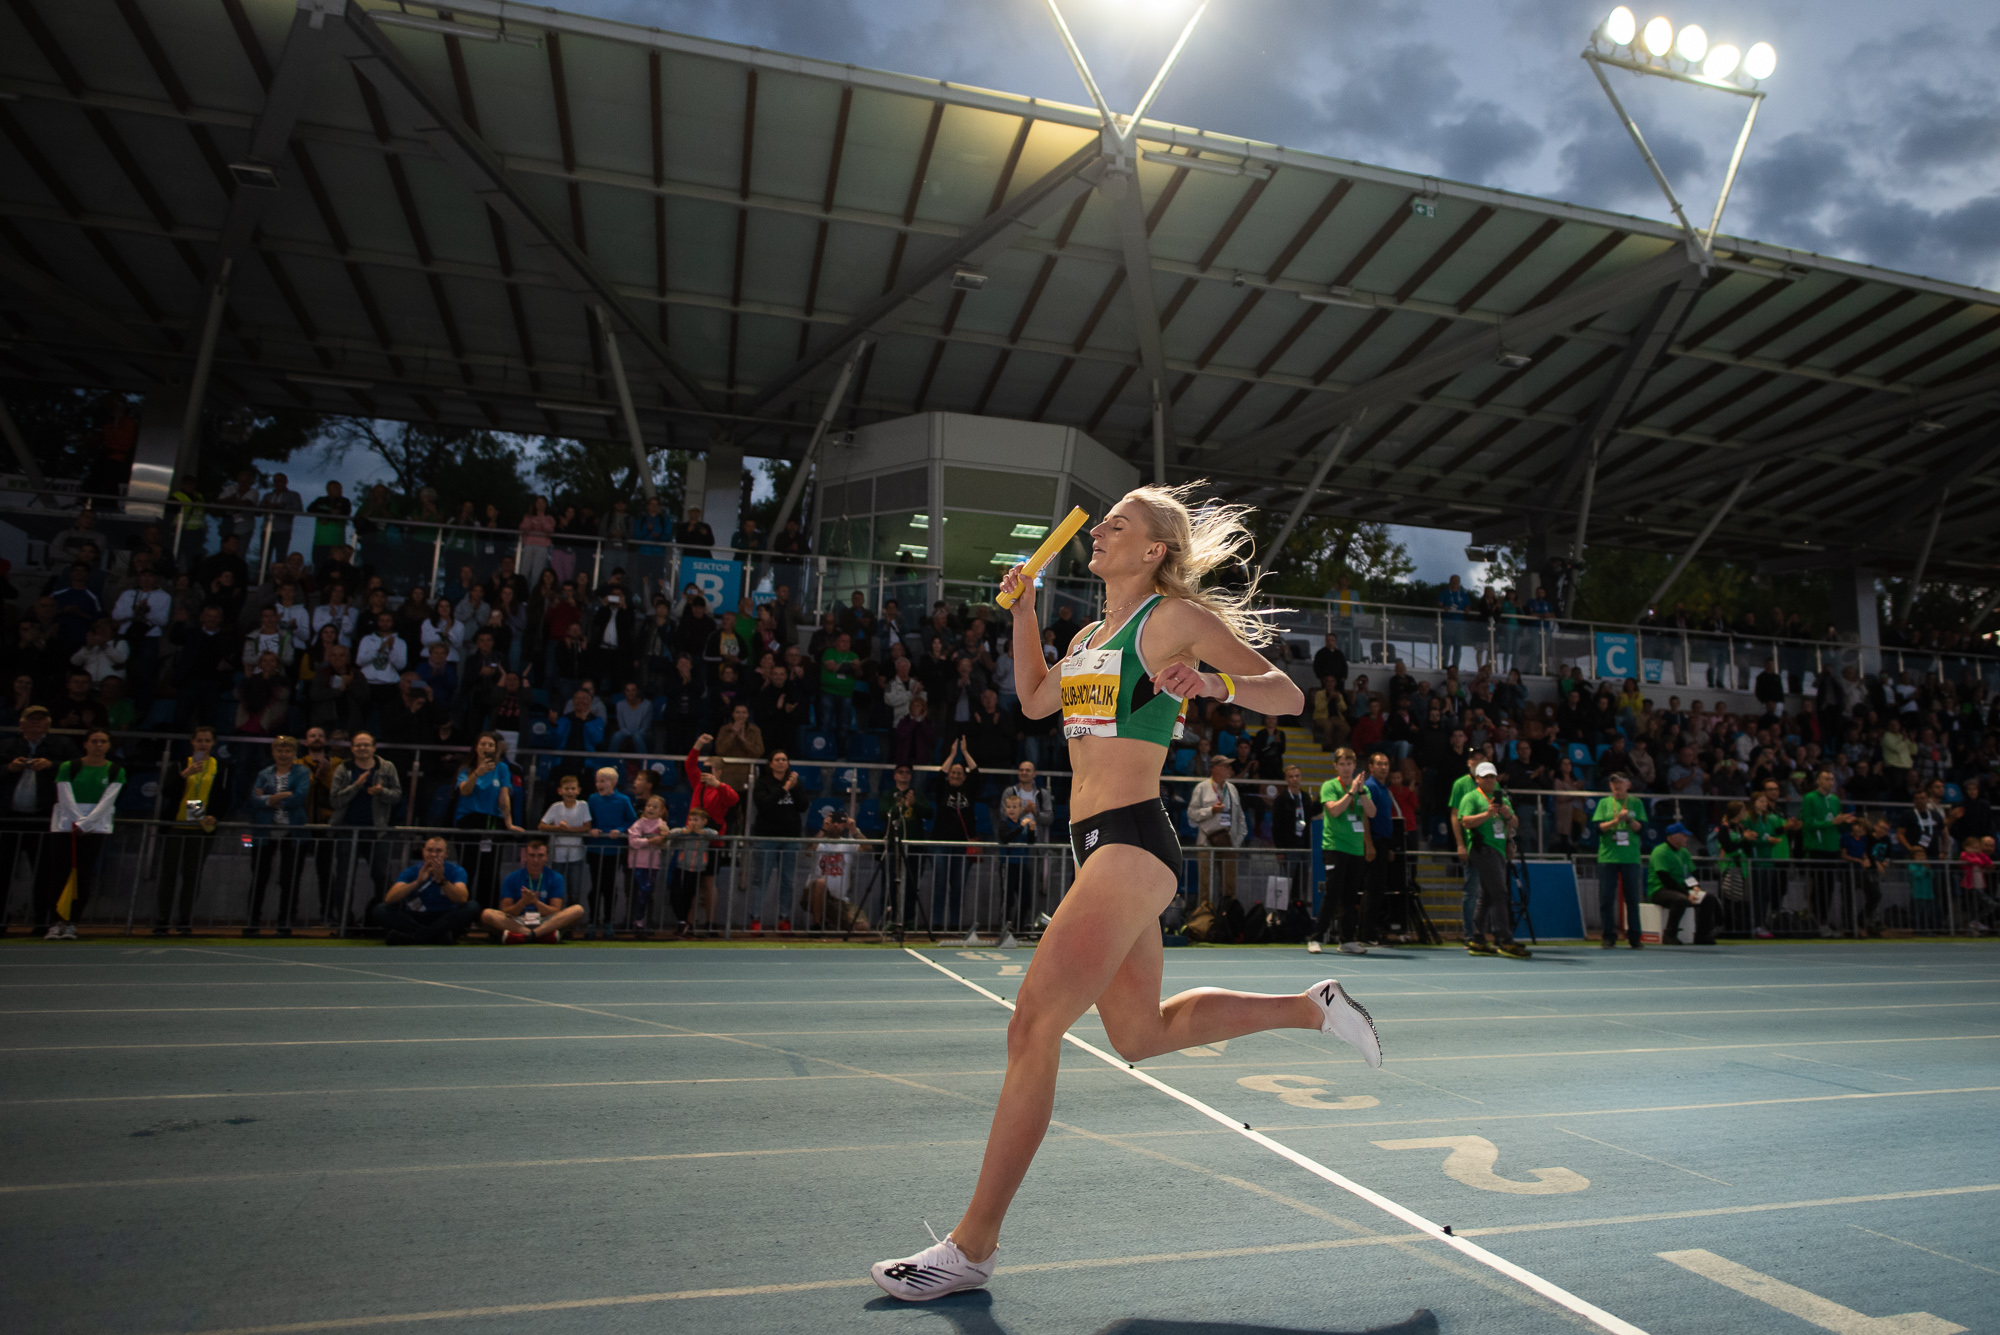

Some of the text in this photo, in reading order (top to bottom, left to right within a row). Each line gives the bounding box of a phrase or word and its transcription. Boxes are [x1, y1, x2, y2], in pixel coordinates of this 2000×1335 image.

[692, 561, 730, 573] SEKTOR
[694, 573, 724, 616] B
[1093, 653, 1110, 670] 5
[1605, 645, 1628, 675] C
[1073, 726, 1092, 736] 2021
[1236, 1074, 1381, 1110] 3
[1370, 1135, 1591, 1195] 2
